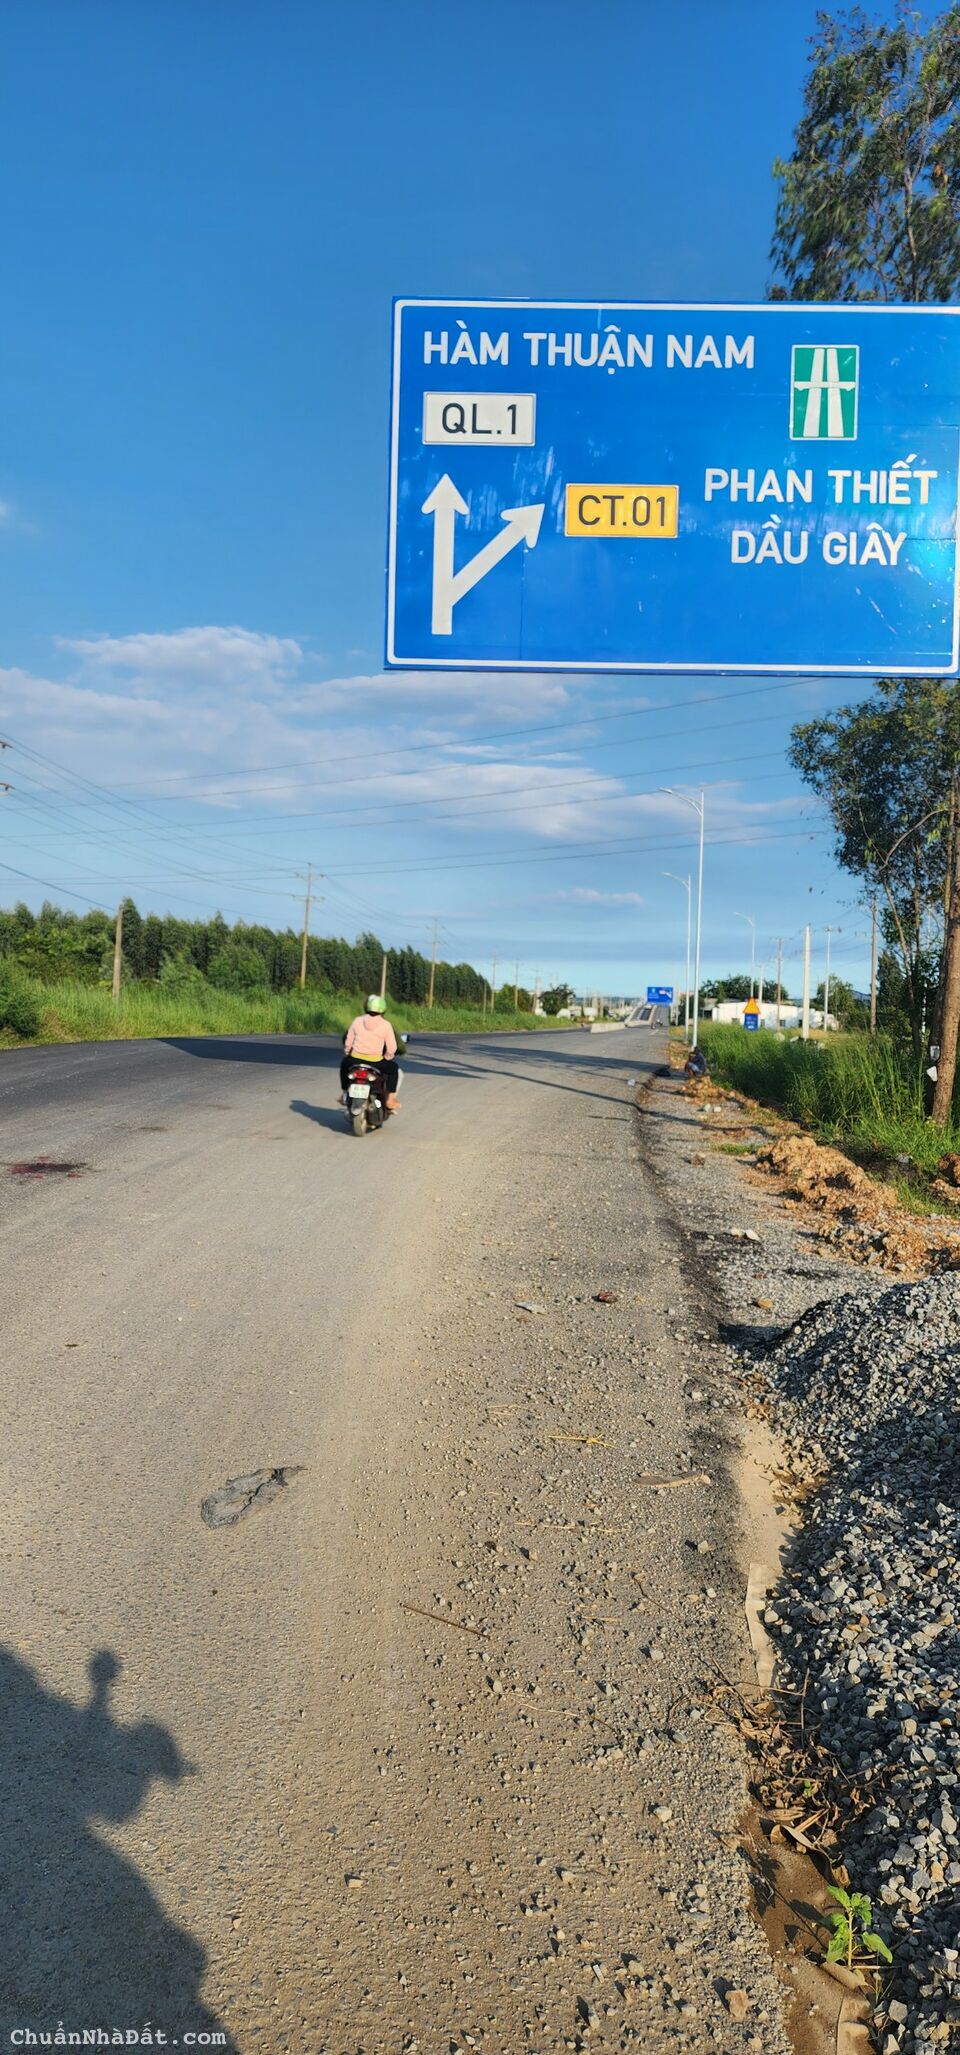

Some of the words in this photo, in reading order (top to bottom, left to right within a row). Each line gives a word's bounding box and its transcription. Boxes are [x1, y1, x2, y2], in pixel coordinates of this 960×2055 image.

[423, 320, 509, 366] HÀM
[523, 325, 653, 375] THUẬN
[666, 335, 755, 369] NAM
[441, 403, 517, 435] QL.1
[704, 468, 812, 503] PHAN
[828, 454, 937, 505] THIẾT
[578, 495, 667, 527] CT.01
[731, 514, 808, 565] DẦU
[822, 523, 907, 566] GIÂY
